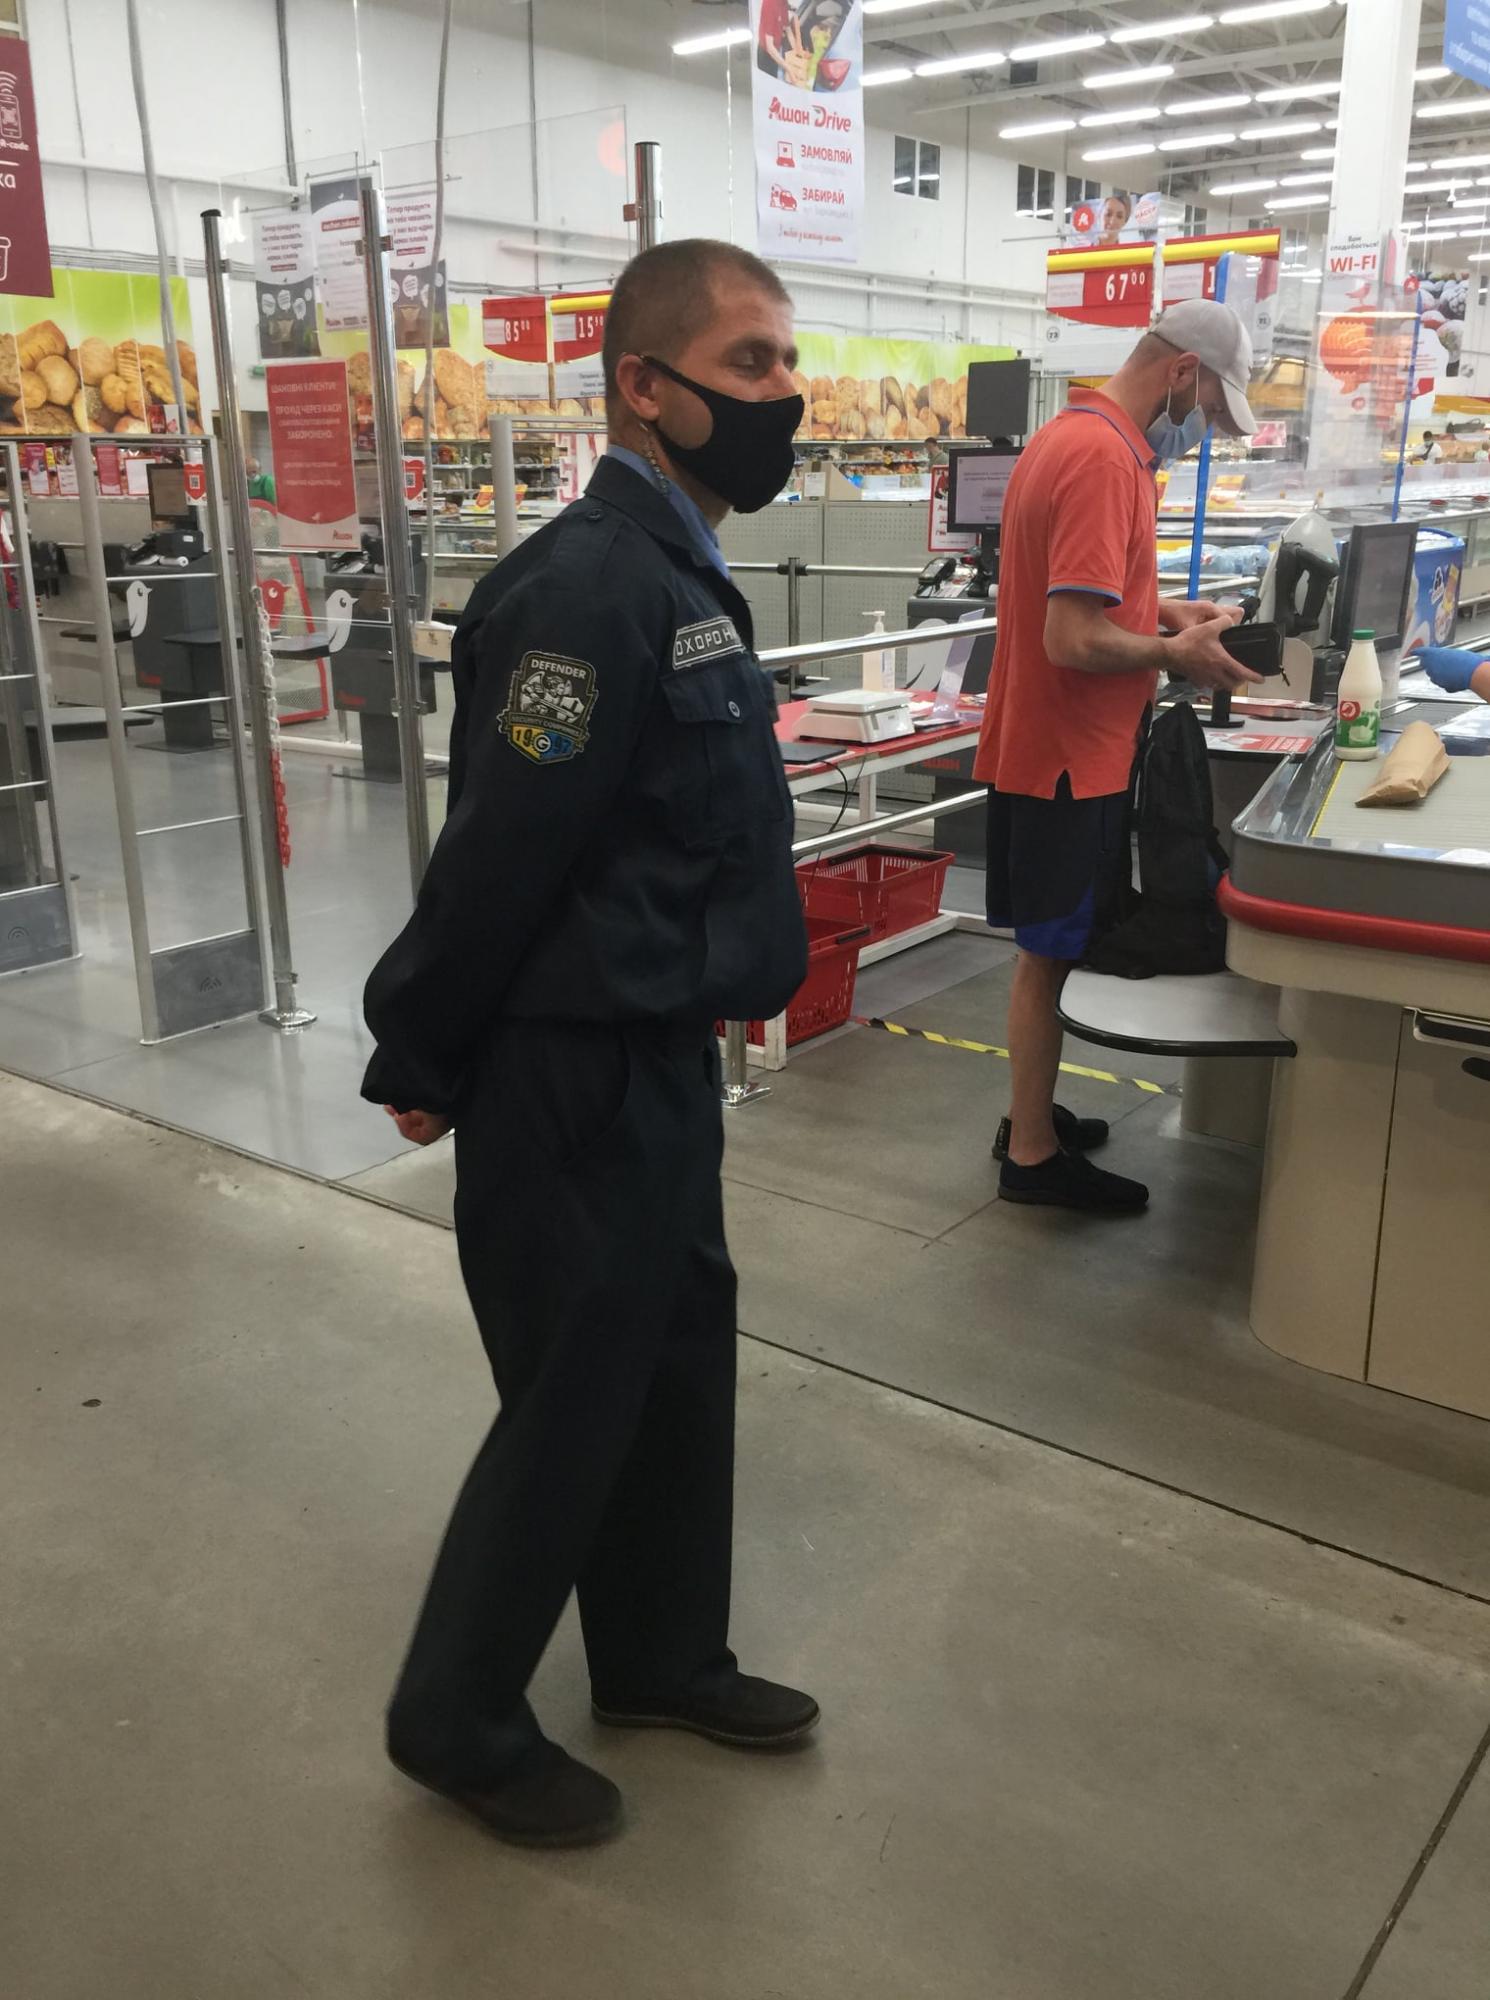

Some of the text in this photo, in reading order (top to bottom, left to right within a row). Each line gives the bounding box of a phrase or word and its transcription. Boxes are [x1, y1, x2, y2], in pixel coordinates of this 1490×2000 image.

[768, 96, 852, 132] Ашан Drive
[800, 143, 853, 165] ЗАМОВЛЯЙ
[802, 186, 845, 205] ЗАБИРАЙ
[1330, 254, 1377, 273] WI-FI
[530, 658, 588, 680] DEFENDER
